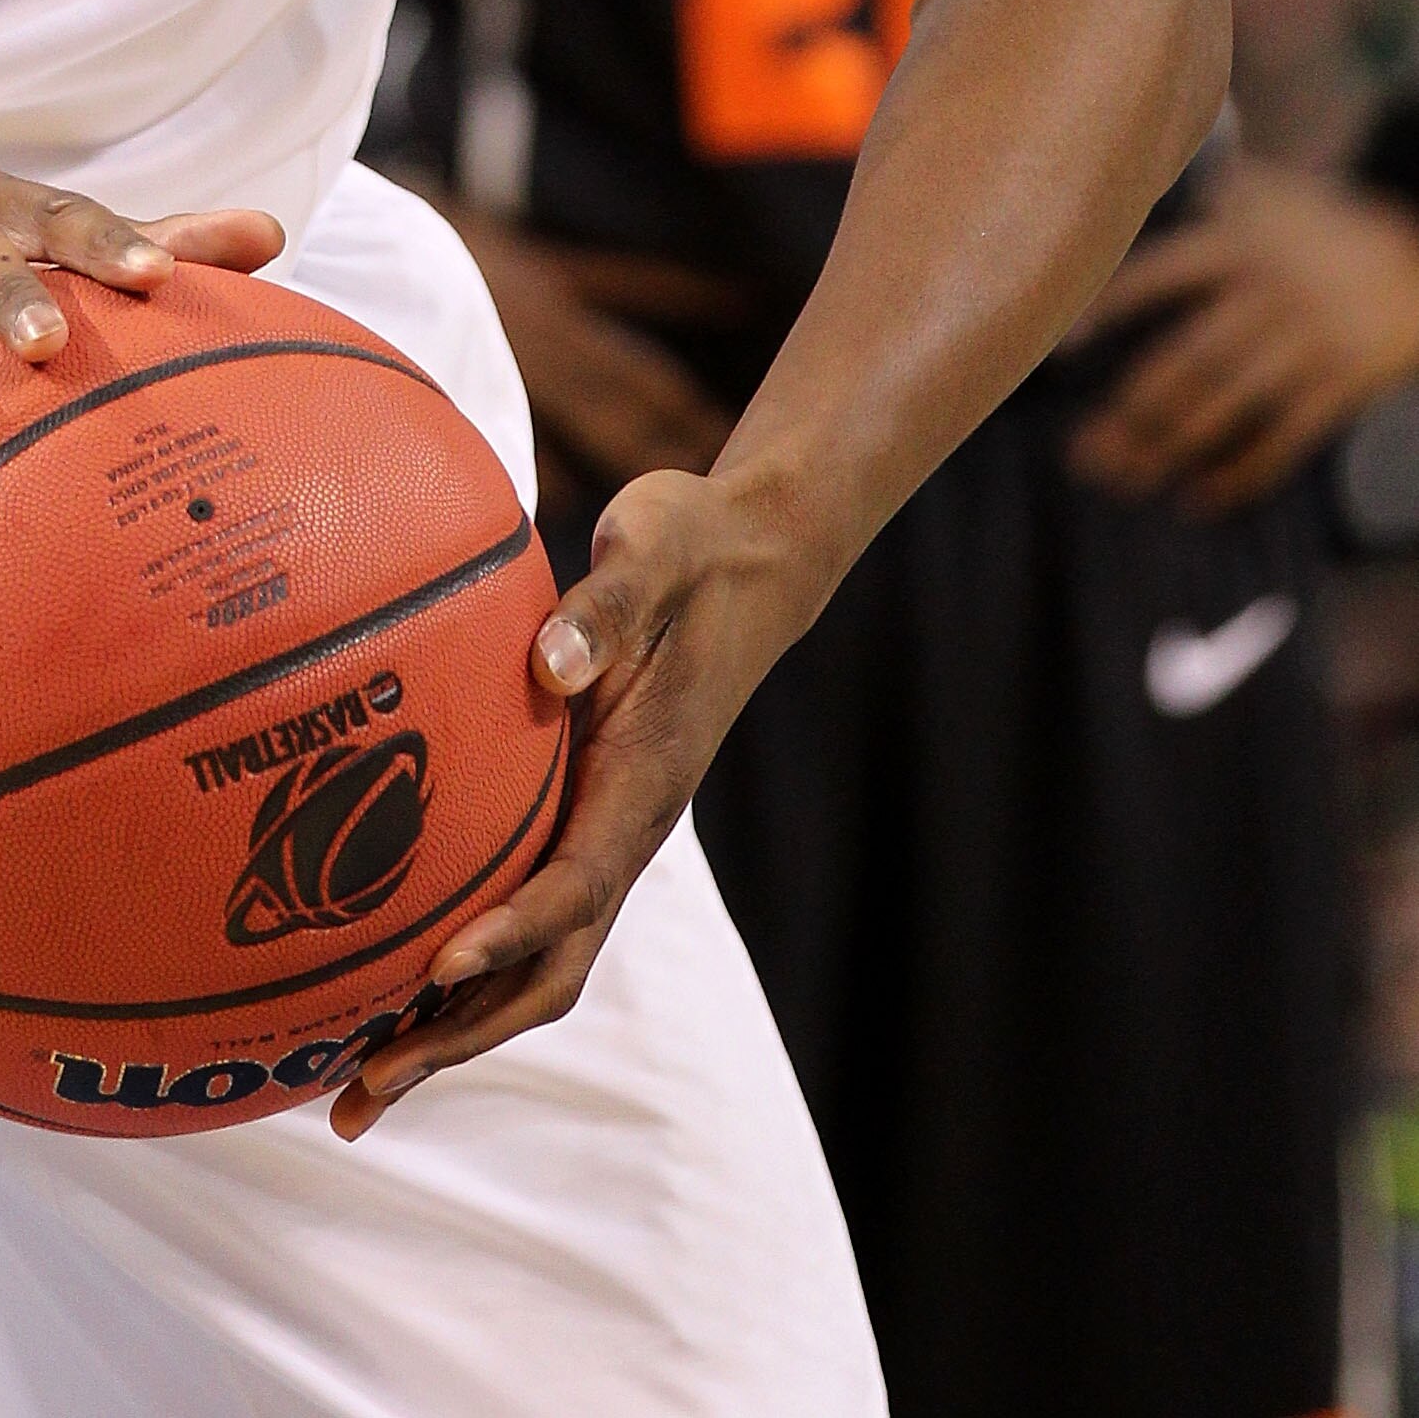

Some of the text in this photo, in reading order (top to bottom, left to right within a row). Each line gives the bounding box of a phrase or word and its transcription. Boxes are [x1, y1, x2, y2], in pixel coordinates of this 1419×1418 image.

[176, 424, 218, 449] MADE
[107, 452, 155, 483] CHINA
[107, 479, 148, 506] ONLY
[184, 689, 368, 793] BASKETBALL
